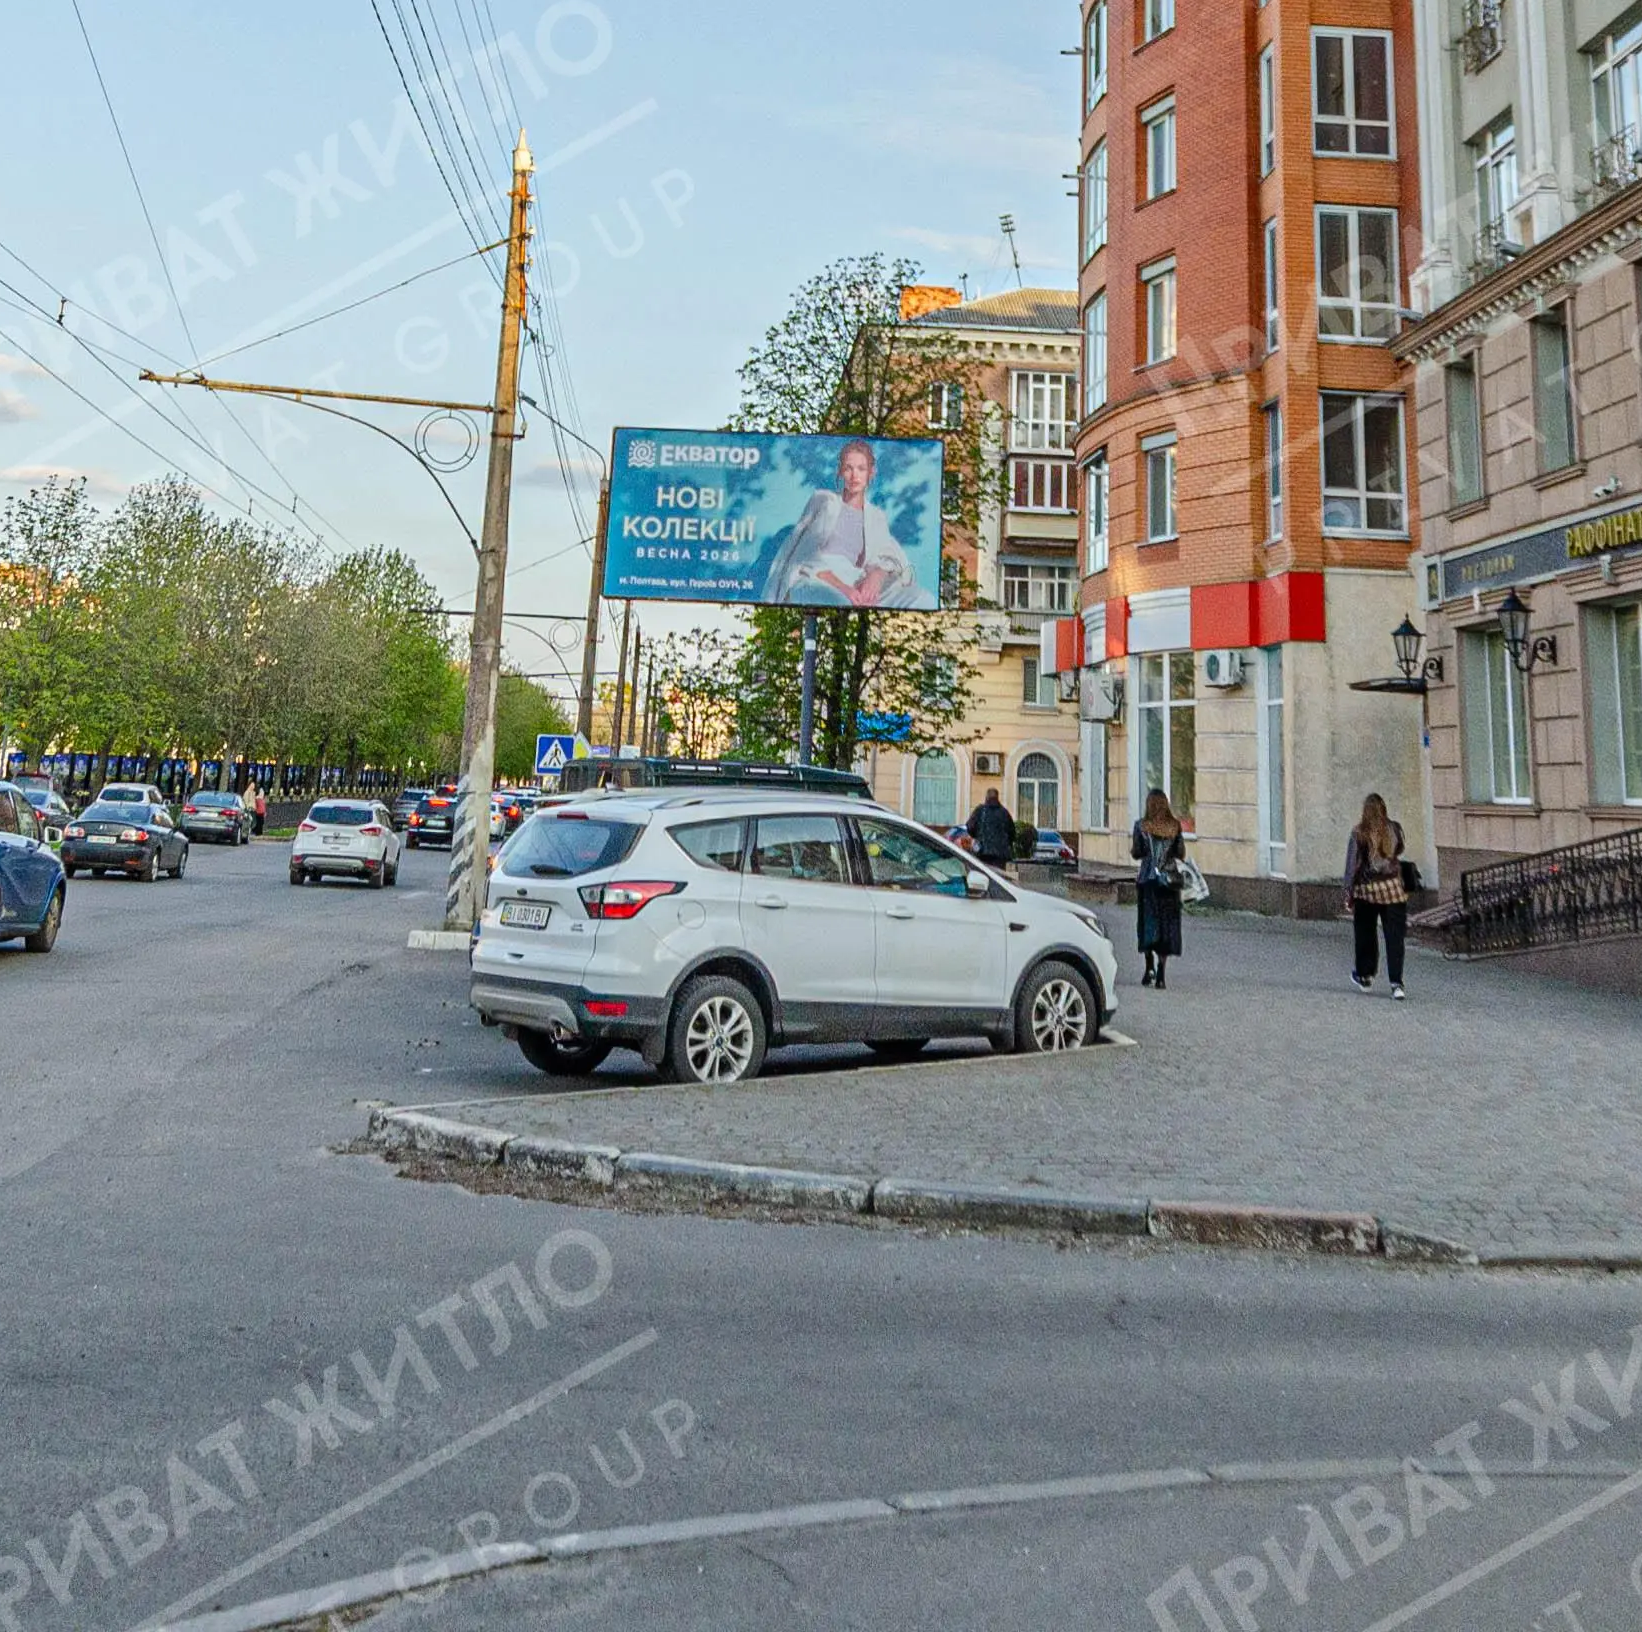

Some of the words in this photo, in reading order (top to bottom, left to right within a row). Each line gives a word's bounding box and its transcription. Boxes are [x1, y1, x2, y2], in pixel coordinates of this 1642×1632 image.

[657, 486, 724, 509] НОВІ
[623, 515, 756, 544] КОЛЕКЦІЇ
[637, 547, 691, 560] ВЕСНА
[701, 550, 740, 561] 2026
